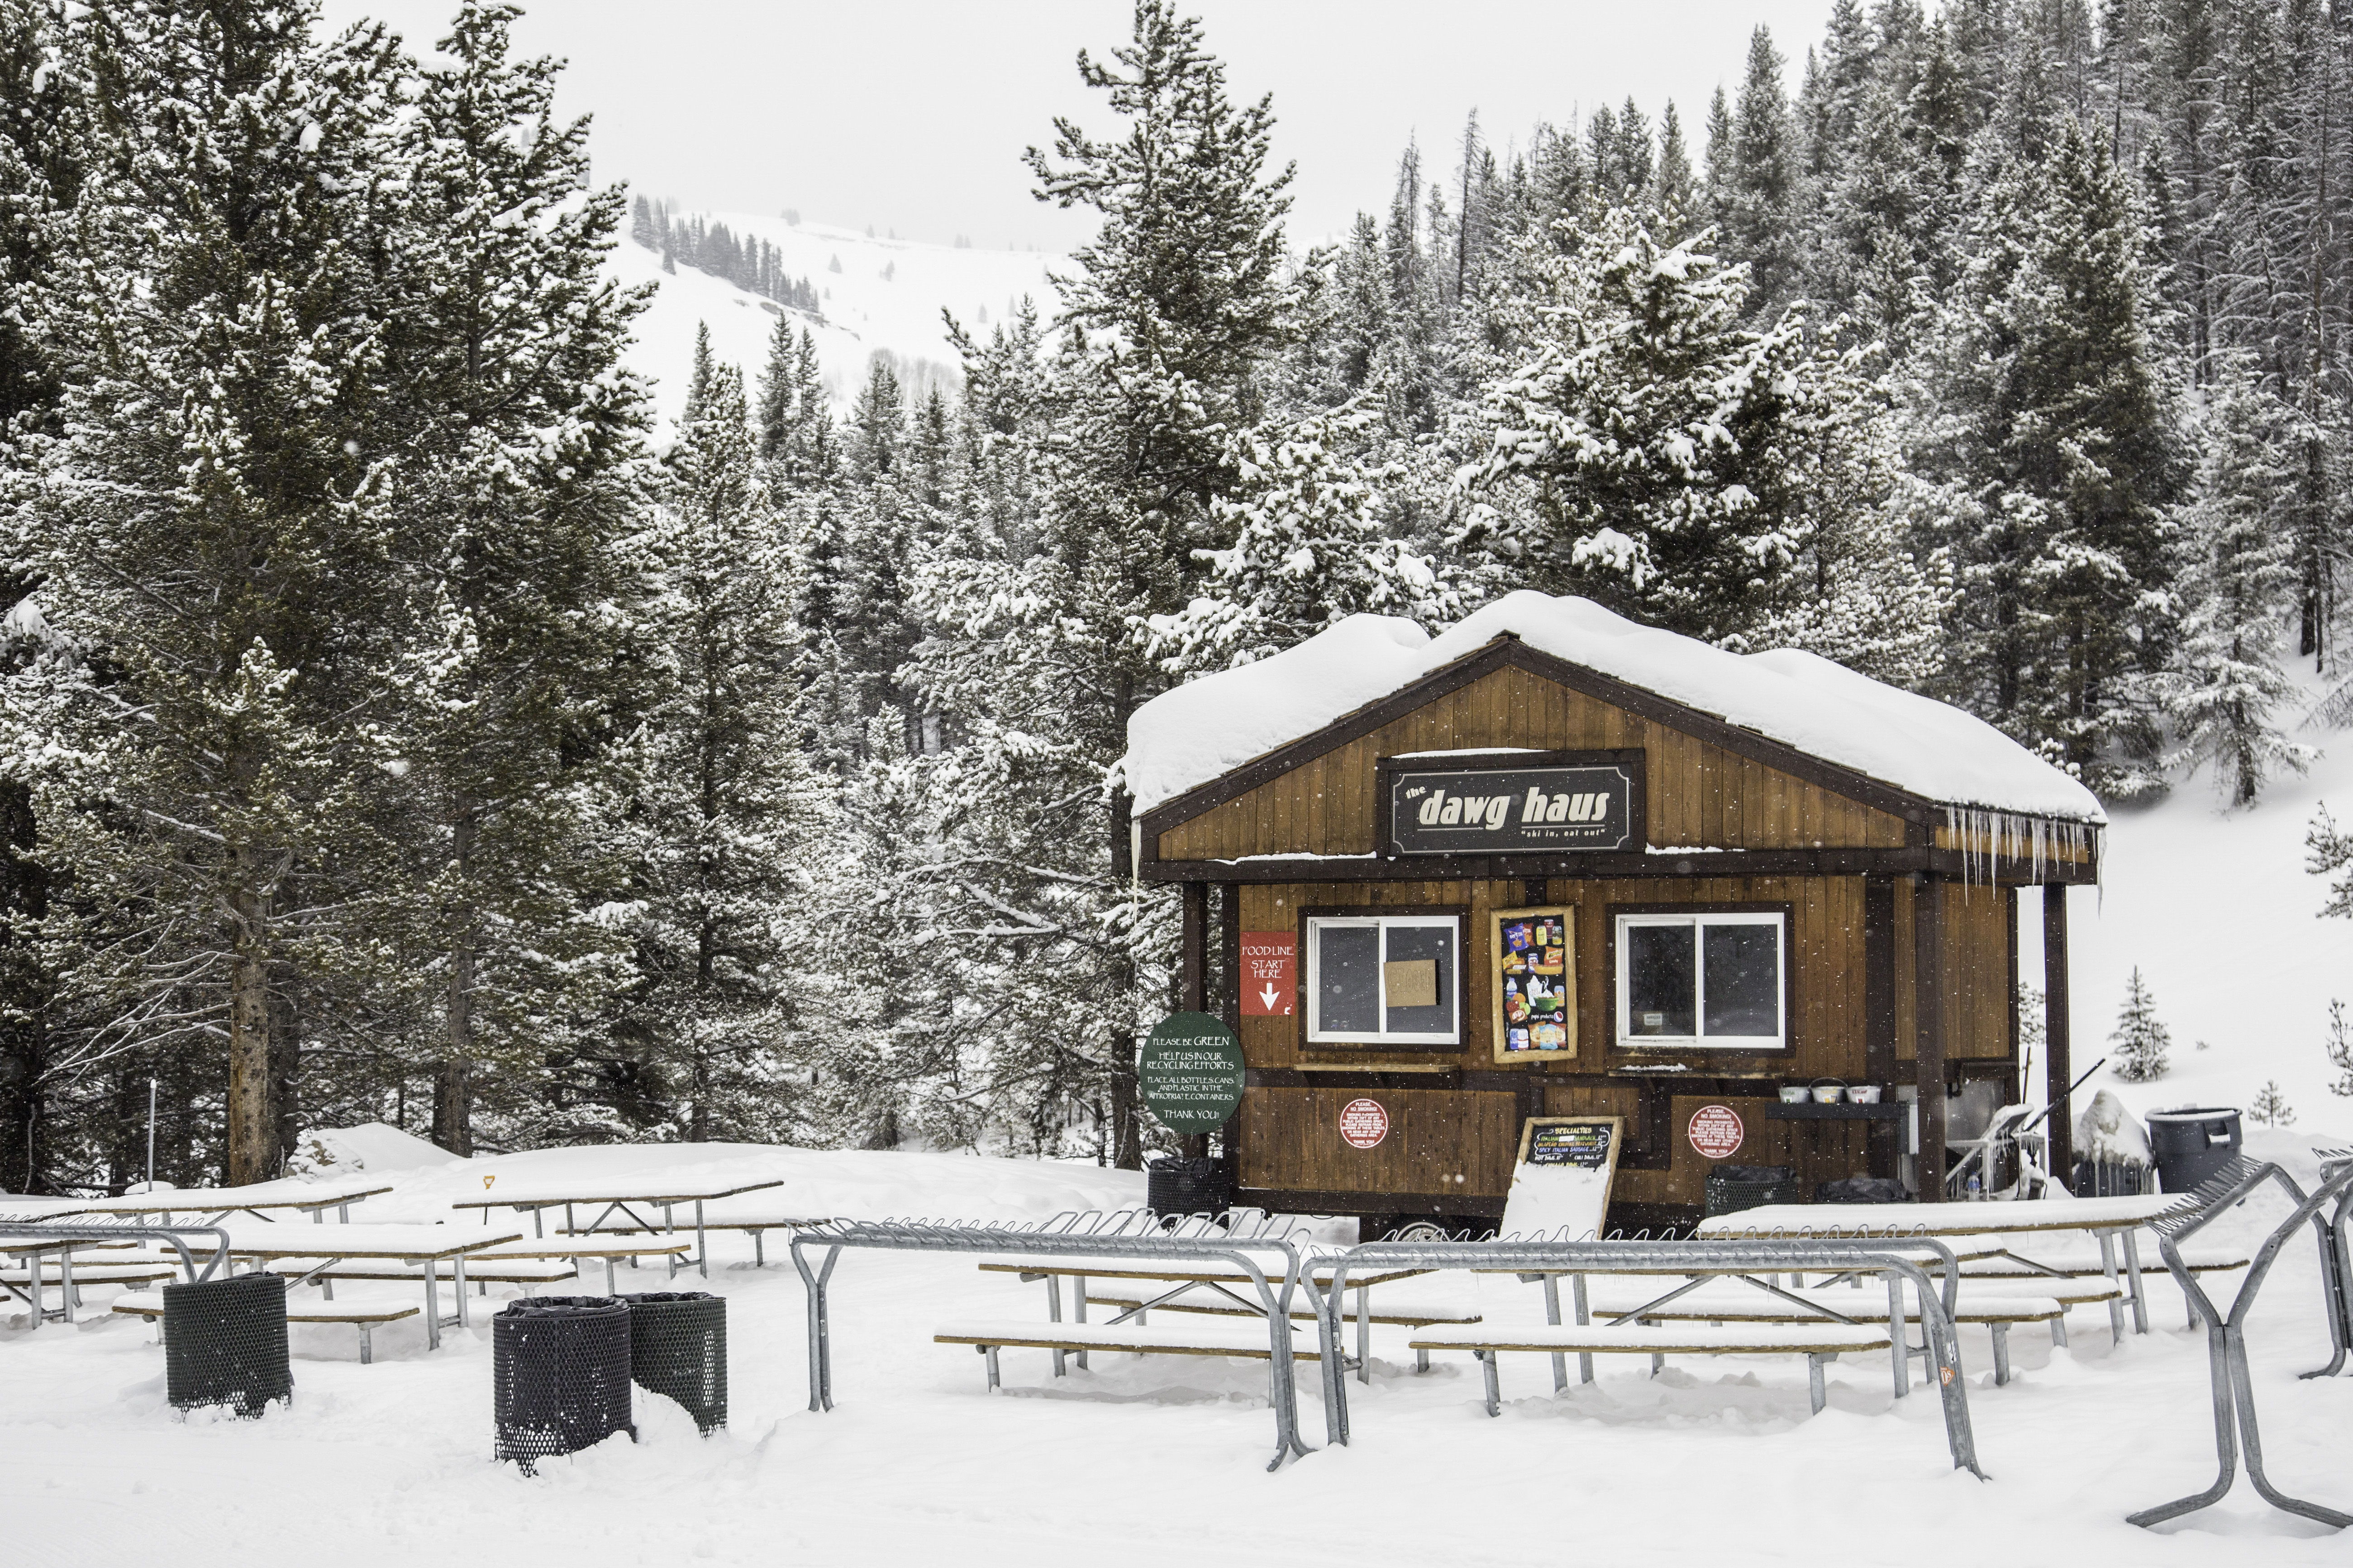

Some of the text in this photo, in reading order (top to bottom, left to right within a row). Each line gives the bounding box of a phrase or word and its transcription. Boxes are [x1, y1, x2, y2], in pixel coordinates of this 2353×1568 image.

[1405, 786, 1426, 799] the
[1419, 787, 1610, 830] dawg haus
[1545, 829, 1558, 837] in,
[1242, 946, 1294, 955] FOOD LINE
[1251, 960, 1285, 969] START
[1254, 969, 1282, 978] HERE
[1387, 968, 1433, 994] CLOSED
[1194, 1036, 1229, 1046] GREEN
[1159, 1052, 1180, 1060] HELP
[1194, 1061, 1234, 1070] EFFORTS
[1164, 1110, 1219, 1119] THANK YOU!!
